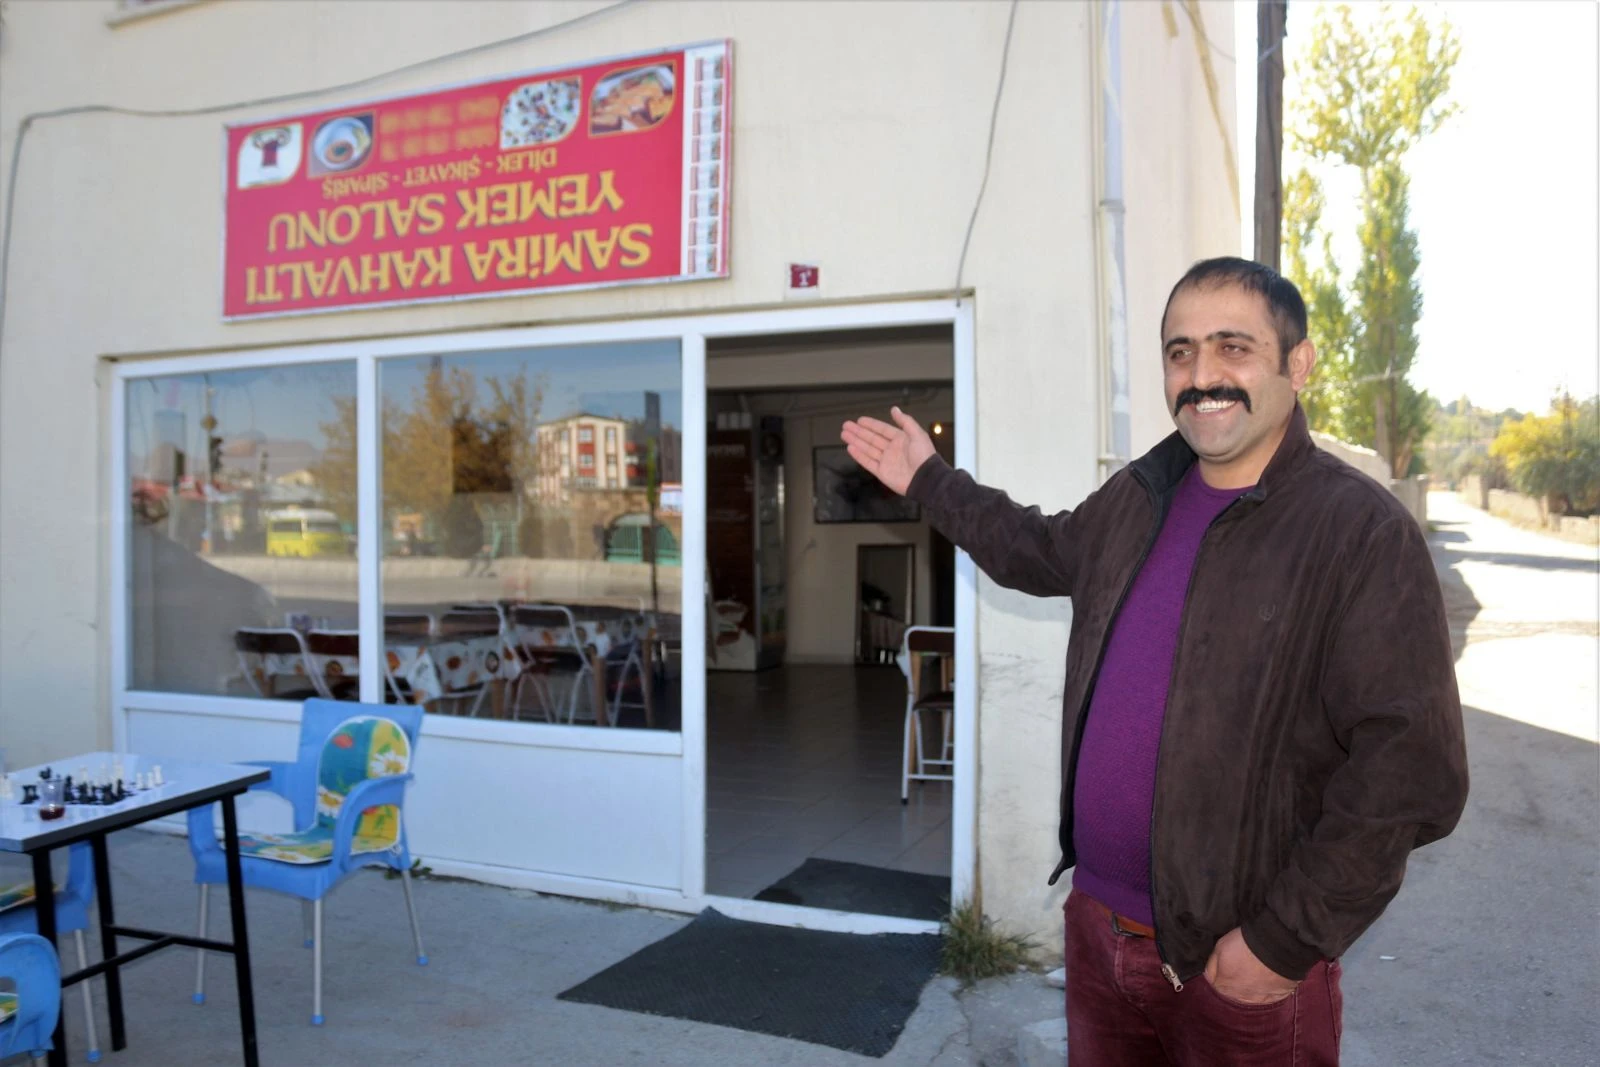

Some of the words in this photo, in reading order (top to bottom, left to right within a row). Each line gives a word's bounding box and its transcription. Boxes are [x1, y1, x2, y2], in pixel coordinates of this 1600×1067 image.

[403, 155, 481, 186] ŞİKAYET
[496, 147, 557, 173] DİLEK
[322, 171, 389, 202] SİPARİŞ
[456, 170, 624, 229] YEMEK
[267, 193, 446, 253] SALONU
[246, 245, 453, 304] KAHVALTI
